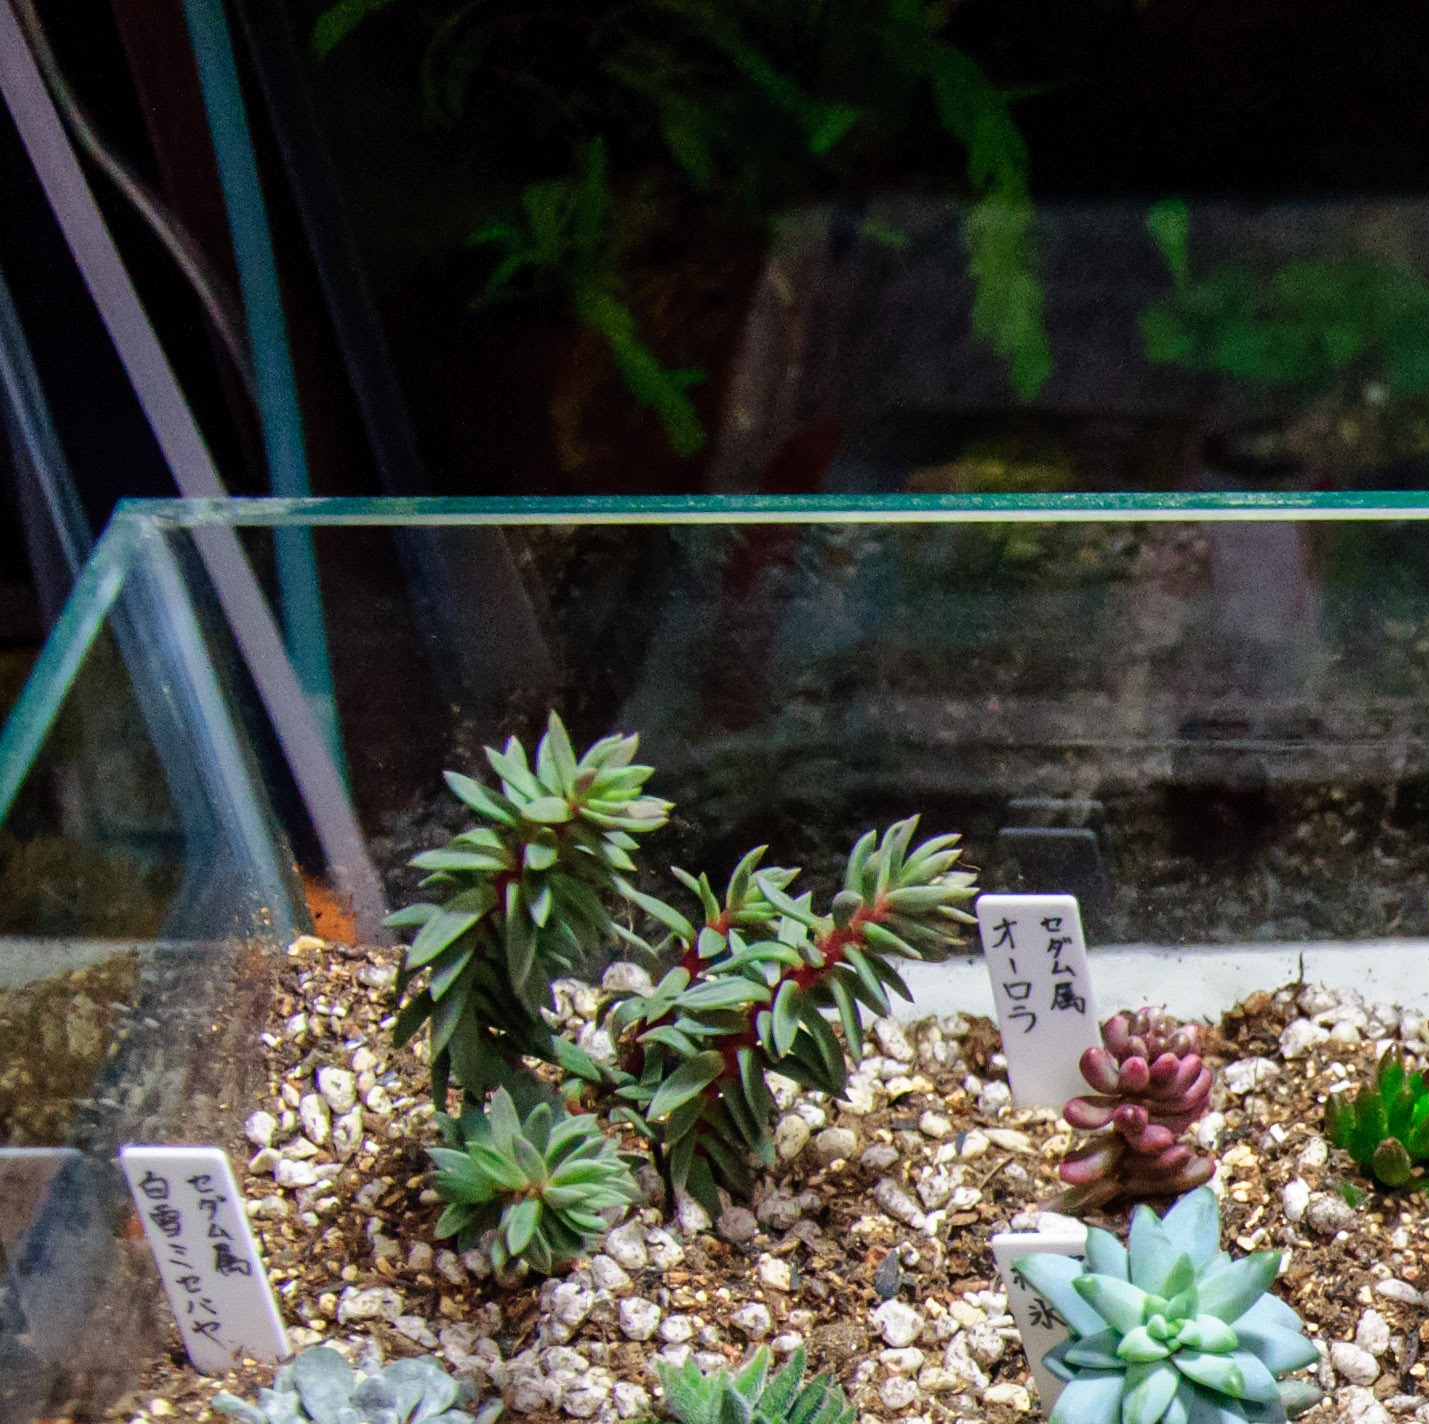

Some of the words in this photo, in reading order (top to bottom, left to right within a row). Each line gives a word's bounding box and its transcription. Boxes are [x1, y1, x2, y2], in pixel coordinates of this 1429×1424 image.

[991, 916, 1037, 1034] オーロラ
[1040, 915, 1086, 1015] セダム属
[185, 1173, 252, 1276] セダム属
